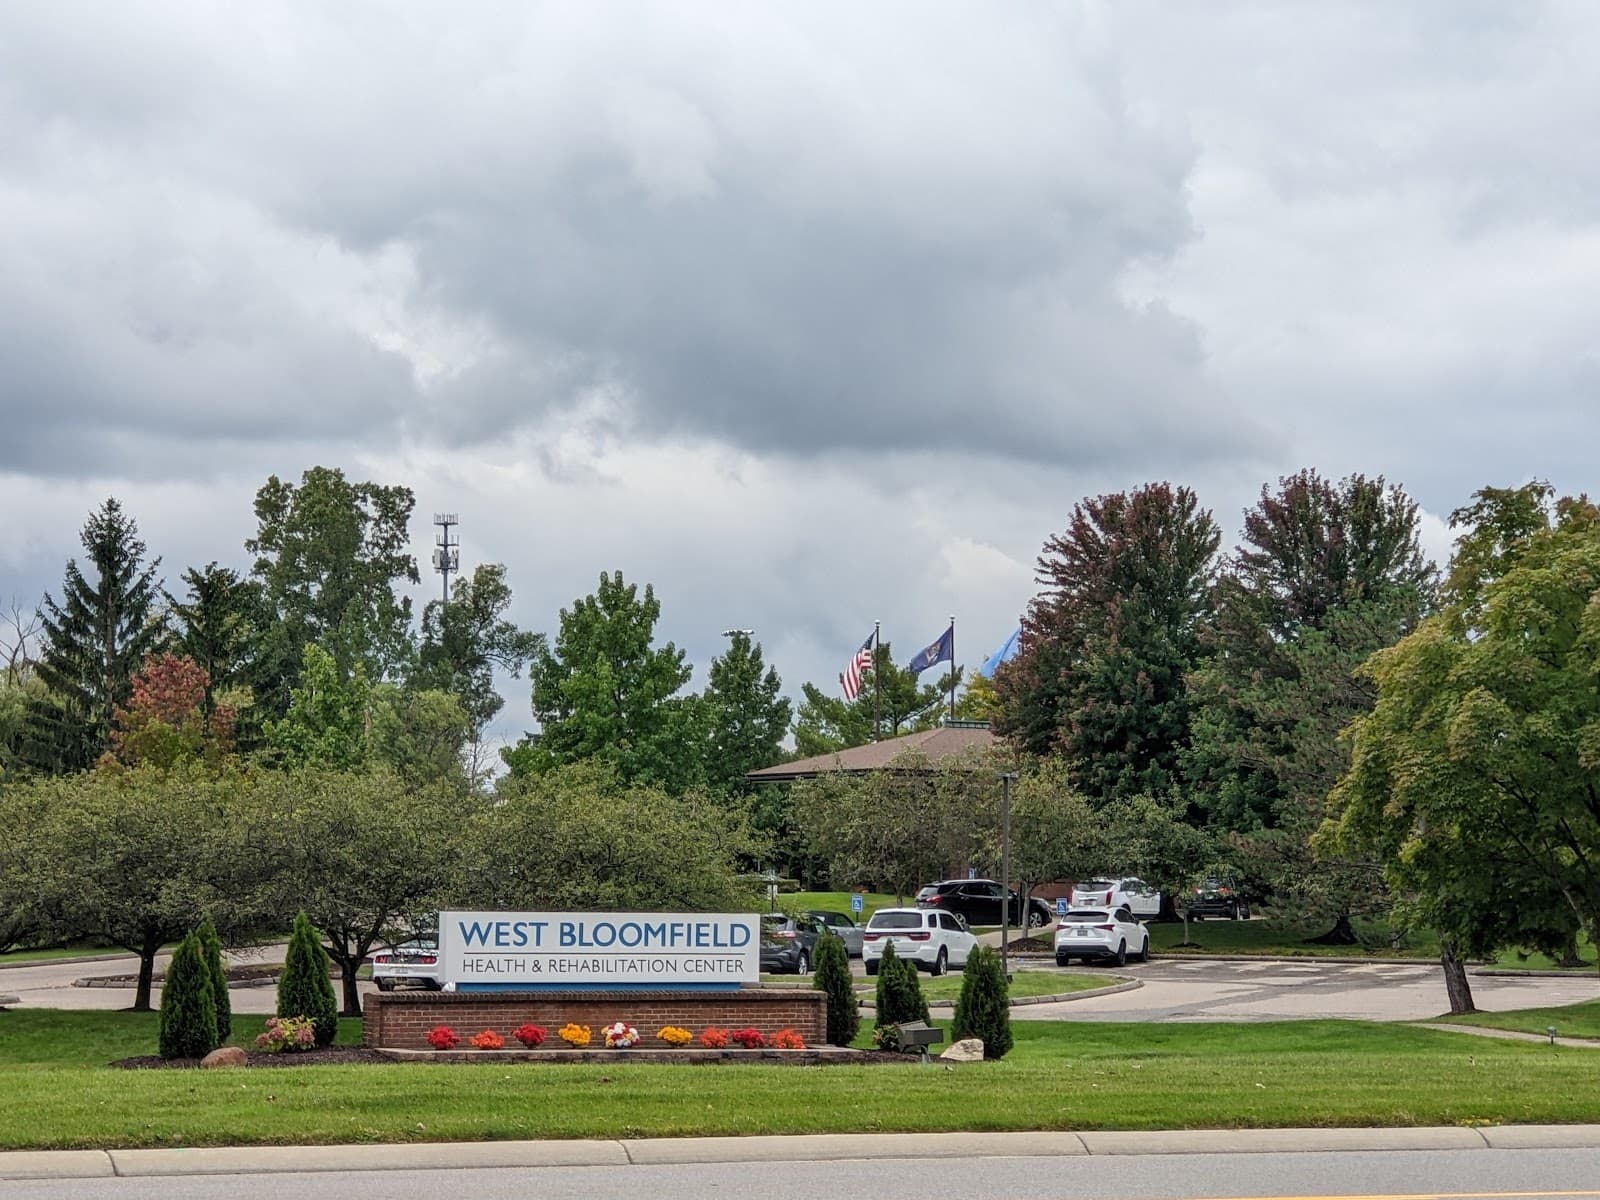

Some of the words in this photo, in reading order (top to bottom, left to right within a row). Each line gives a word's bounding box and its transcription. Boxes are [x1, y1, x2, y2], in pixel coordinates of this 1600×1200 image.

[458, 921, 549, 947] WEST
[559, 922, 751, 948] BLOOMFIELD
[462, 959, 526, 973] HEALTH
[531, 959, 543, 973] &
[548, 959, 677, 973] REHABILITATION
[683, 959, 744, 973] CENTER
